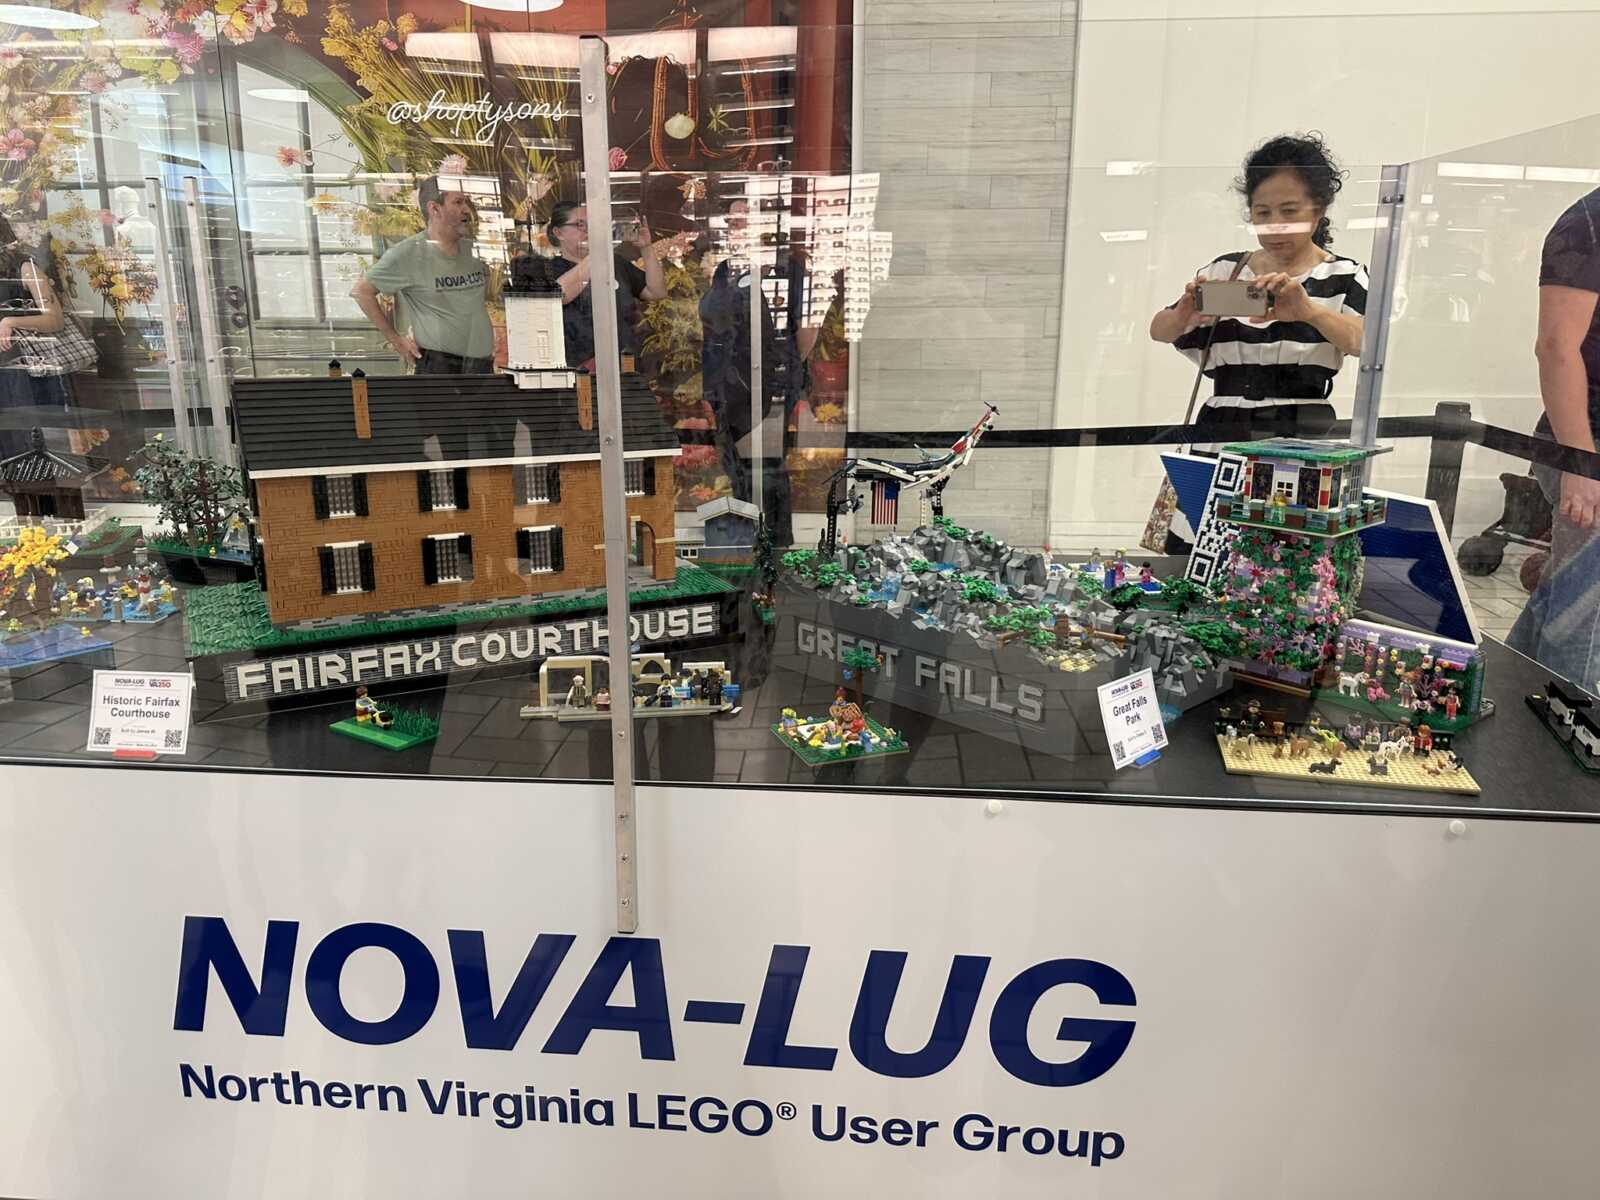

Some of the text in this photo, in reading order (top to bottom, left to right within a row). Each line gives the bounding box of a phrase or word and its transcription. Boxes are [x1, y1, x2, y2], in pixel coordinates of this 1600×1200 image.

[387, 89, 569, 143] @shoptysons
[236, 641, 443, 698] FAIRFAX
[915, 655, 1044, 722] FALLS
[103, 696, 180, 706] Historic Fairfax
[111, 708, 170, 718] Courthouse
[1113, 696, 1147, 716] Great Falls
[1126, 712, 1141, 726] Park
[173, 915, 1138, 1089] NOVA-LUG
[179, 1063, 407, 1113] Northern
[417, 1078, 615, 1129] Virginia
[812, 1104, 940, 1148] User
[953, 1113, 1125, 1167] Group
